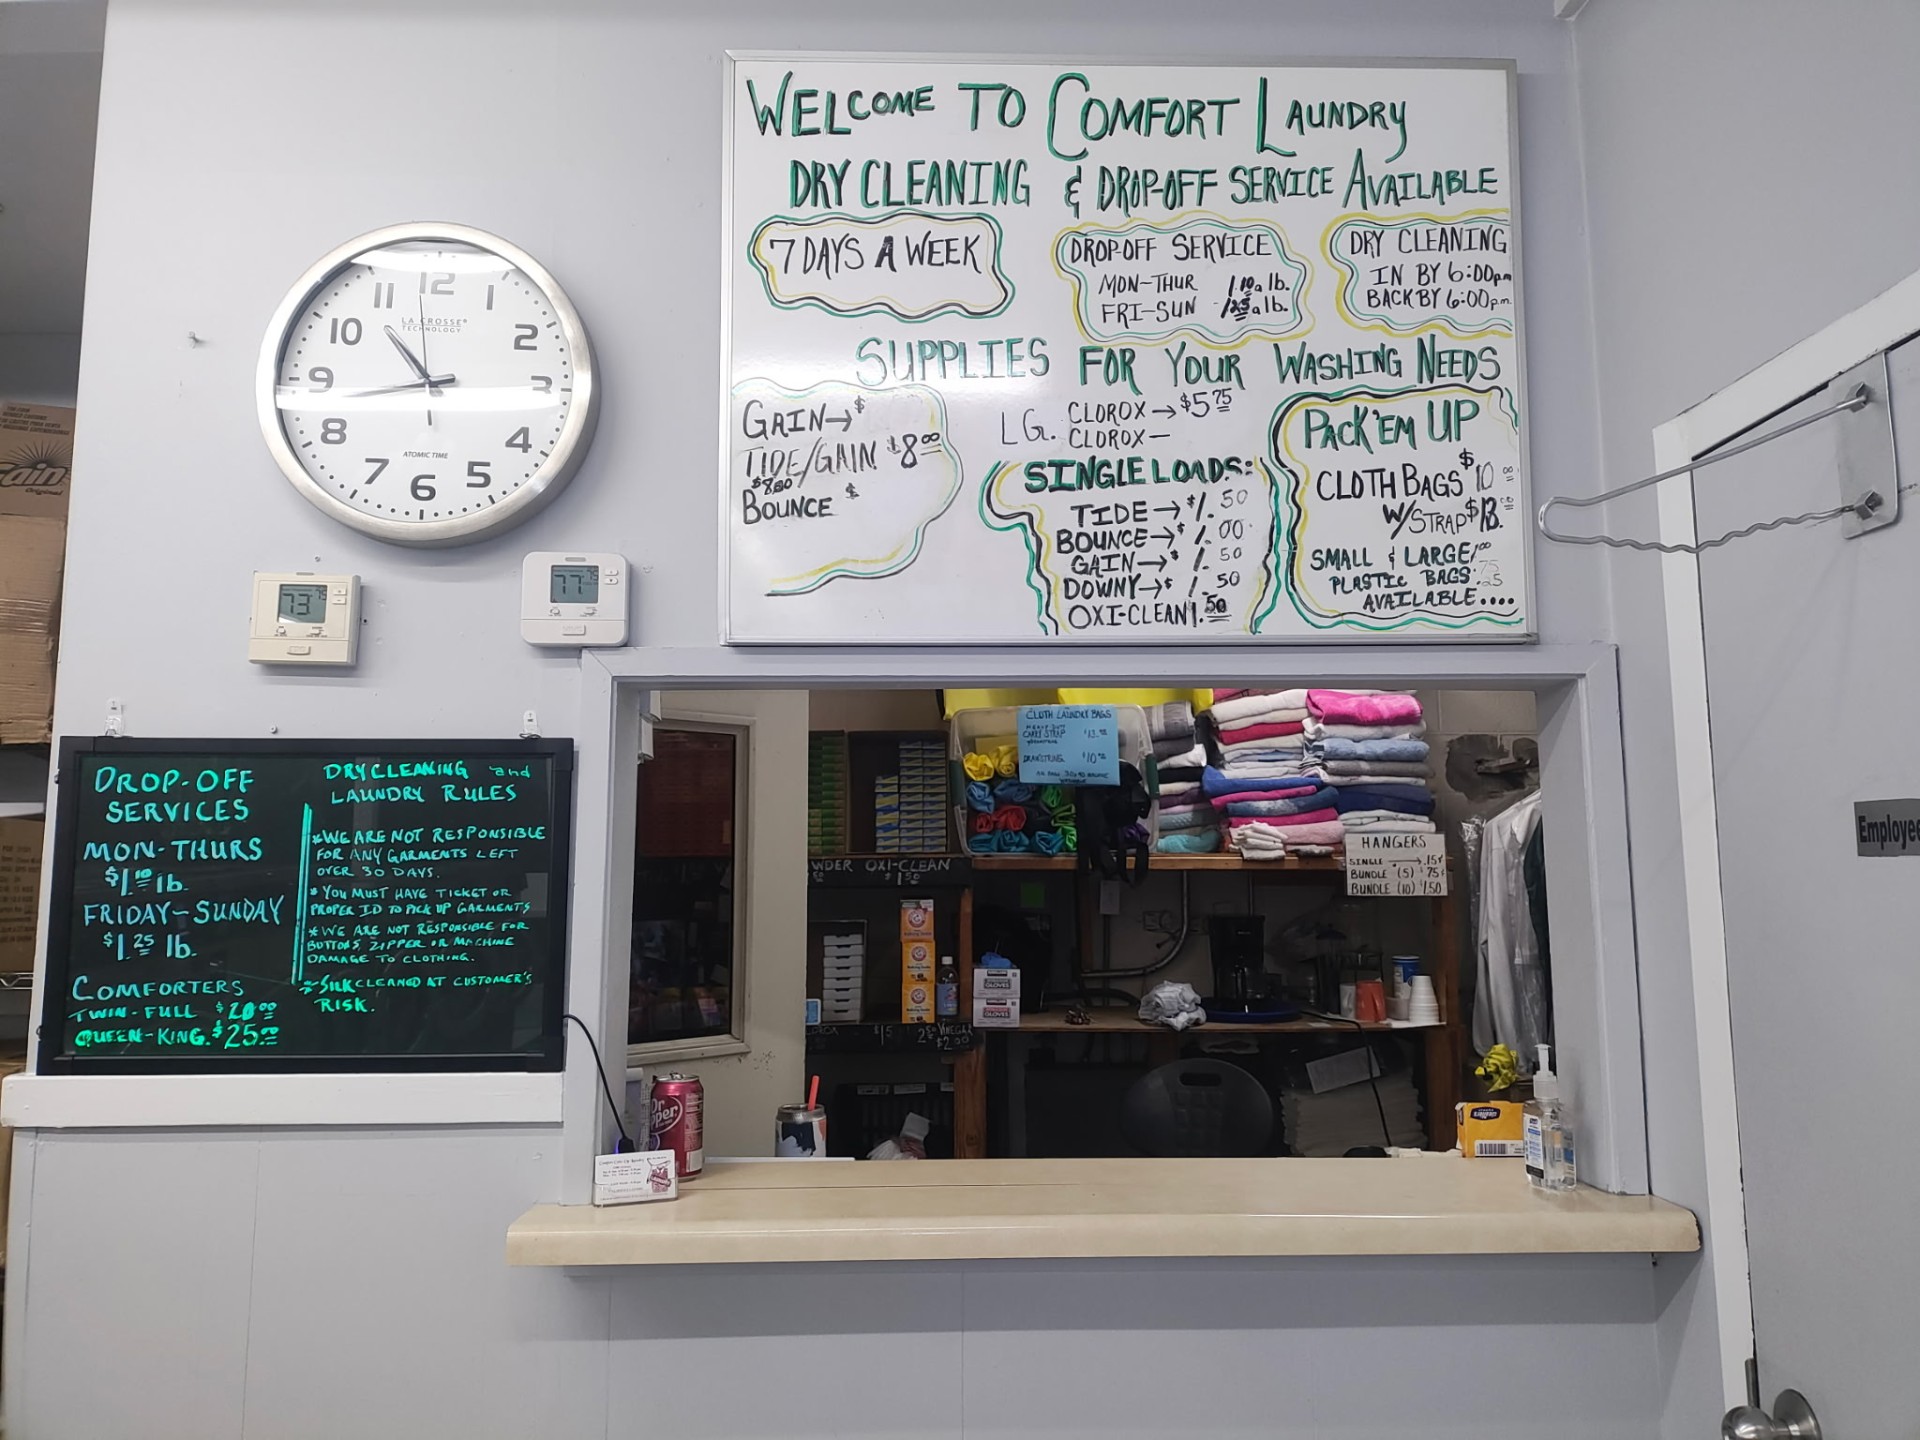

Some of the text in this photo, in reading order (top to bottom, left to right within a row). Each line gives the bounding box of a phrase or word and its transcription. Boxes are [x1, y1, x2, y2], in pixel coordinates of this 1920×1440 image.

[746, 70, 936, 137] WELCOME
[958, 82, 1026, 131] TO
[1047, 72, 1240, 162] COMFORT
[789, 147, 1498, 219] DRY CLEANING & DROP-OFF SERVICE AVAILABLE
[769, 230, 982, 281] 7 DAYS A WEEK
[1070, 233, 1272, 267] DROP-OFF SERVICE
[1350, 225, 1508, 259] DRY CLEANING
[1369, 264, 1404, 286] IN
[1416, 262, 1441, 287] BY
[373, 282, 395, 309] 11
[486, 284, 495, 311] 1
[1366, 288, 1415, 310] BACK
[1416, 287, 1442, 310] BY
[329, 317, 363, 346] 10
[513, 323, 539, 351] 2
[856, 333, 1501, 396] SUPPLIES FOR YOUR WASHING NEEDS
[308, 366, 335, 394] 9
[743, 399, 827, 440] GAIN
[1068, 401, 1147, 427] CLOROX
[1426, 399, 1480, 442] UP
[320, 417, 348, 445] 8
[504, 426, 533, 453] 4
[364, 457, 390, 485] 7
[466, 460, 493, 489] 5
[744, 437, 878, 488] TIDE/GAIN
[1024, 455, 1146, 493] SINGLE
[410, 473, 437, 502] 6
[1316, 463, 1464, 502] CLOTH BAGS
[743, 489, 834, 524] BOUNCE
[1070, 501, 1149, 527] TIDE
[1056, 528, 1149, 554] BOUNCE
[1071, 551, 1136, 578] GAIN
[1310, 549, 1373, 571] SMALL
[1404, 542, 1472, 567] LARGE
[1063, 574, 1142, 600] DOWNY
[1329, 572, 1408, 596] PLASTIC
[282, 592, 310, 616] 73
[1068, 602, 1188, 630] OXI-CLEAN
[94, 766, 255, 794] DROP-OFF
[331, 783, 517, 805] LAUNDRY RULES
[105, 798, 250, 823] SERVICES
[354, 828, 386, 846] ARE
[390, 827, 424, 844] NOT
[432, 826, 547, 844] RESPONSIBLE
[1361, 835, 1427, 849] HANGERS
[316, 848, 519, 865] FOR ANY GARMENTS LEFT
[811, 859, 853, 872] WDER
[1349, 857, 1384, 866] SINGLE
[316, 866, 354, 878] OVER
[362, 866, 385, 878] 30
[1350, 869, 1388, 879] BUNDLE
[322, 885, 512, 901] YOU MUST HAVE TICKET OR
[1351, 883, 1391, 895] BUNDLE
[310, 901, 532, 918] PROPER ID TO PICK UP GARMENTS
[353, 924, 380, 937] ARE
[387, 924, 410, 935] NOT
[416, 921, 495, 935] RESPONSIBLE
[501, 921, 530, 932] FOR
[369, 939, 427, 951] ZIPPER
[431, 938, 449, 947] OR
[453, 936, 515, 947] MACHINE
[307, 954, 370, 964] DAMAGE
[375, 954, 396, 964] TO
[72, 975, 245, 1001] COMFORTERS
[355, 976, 421, 988] CLEANED
[426, 976, 447, 988] AT
[453, 970, 533, 987] CUSTOMER'S
